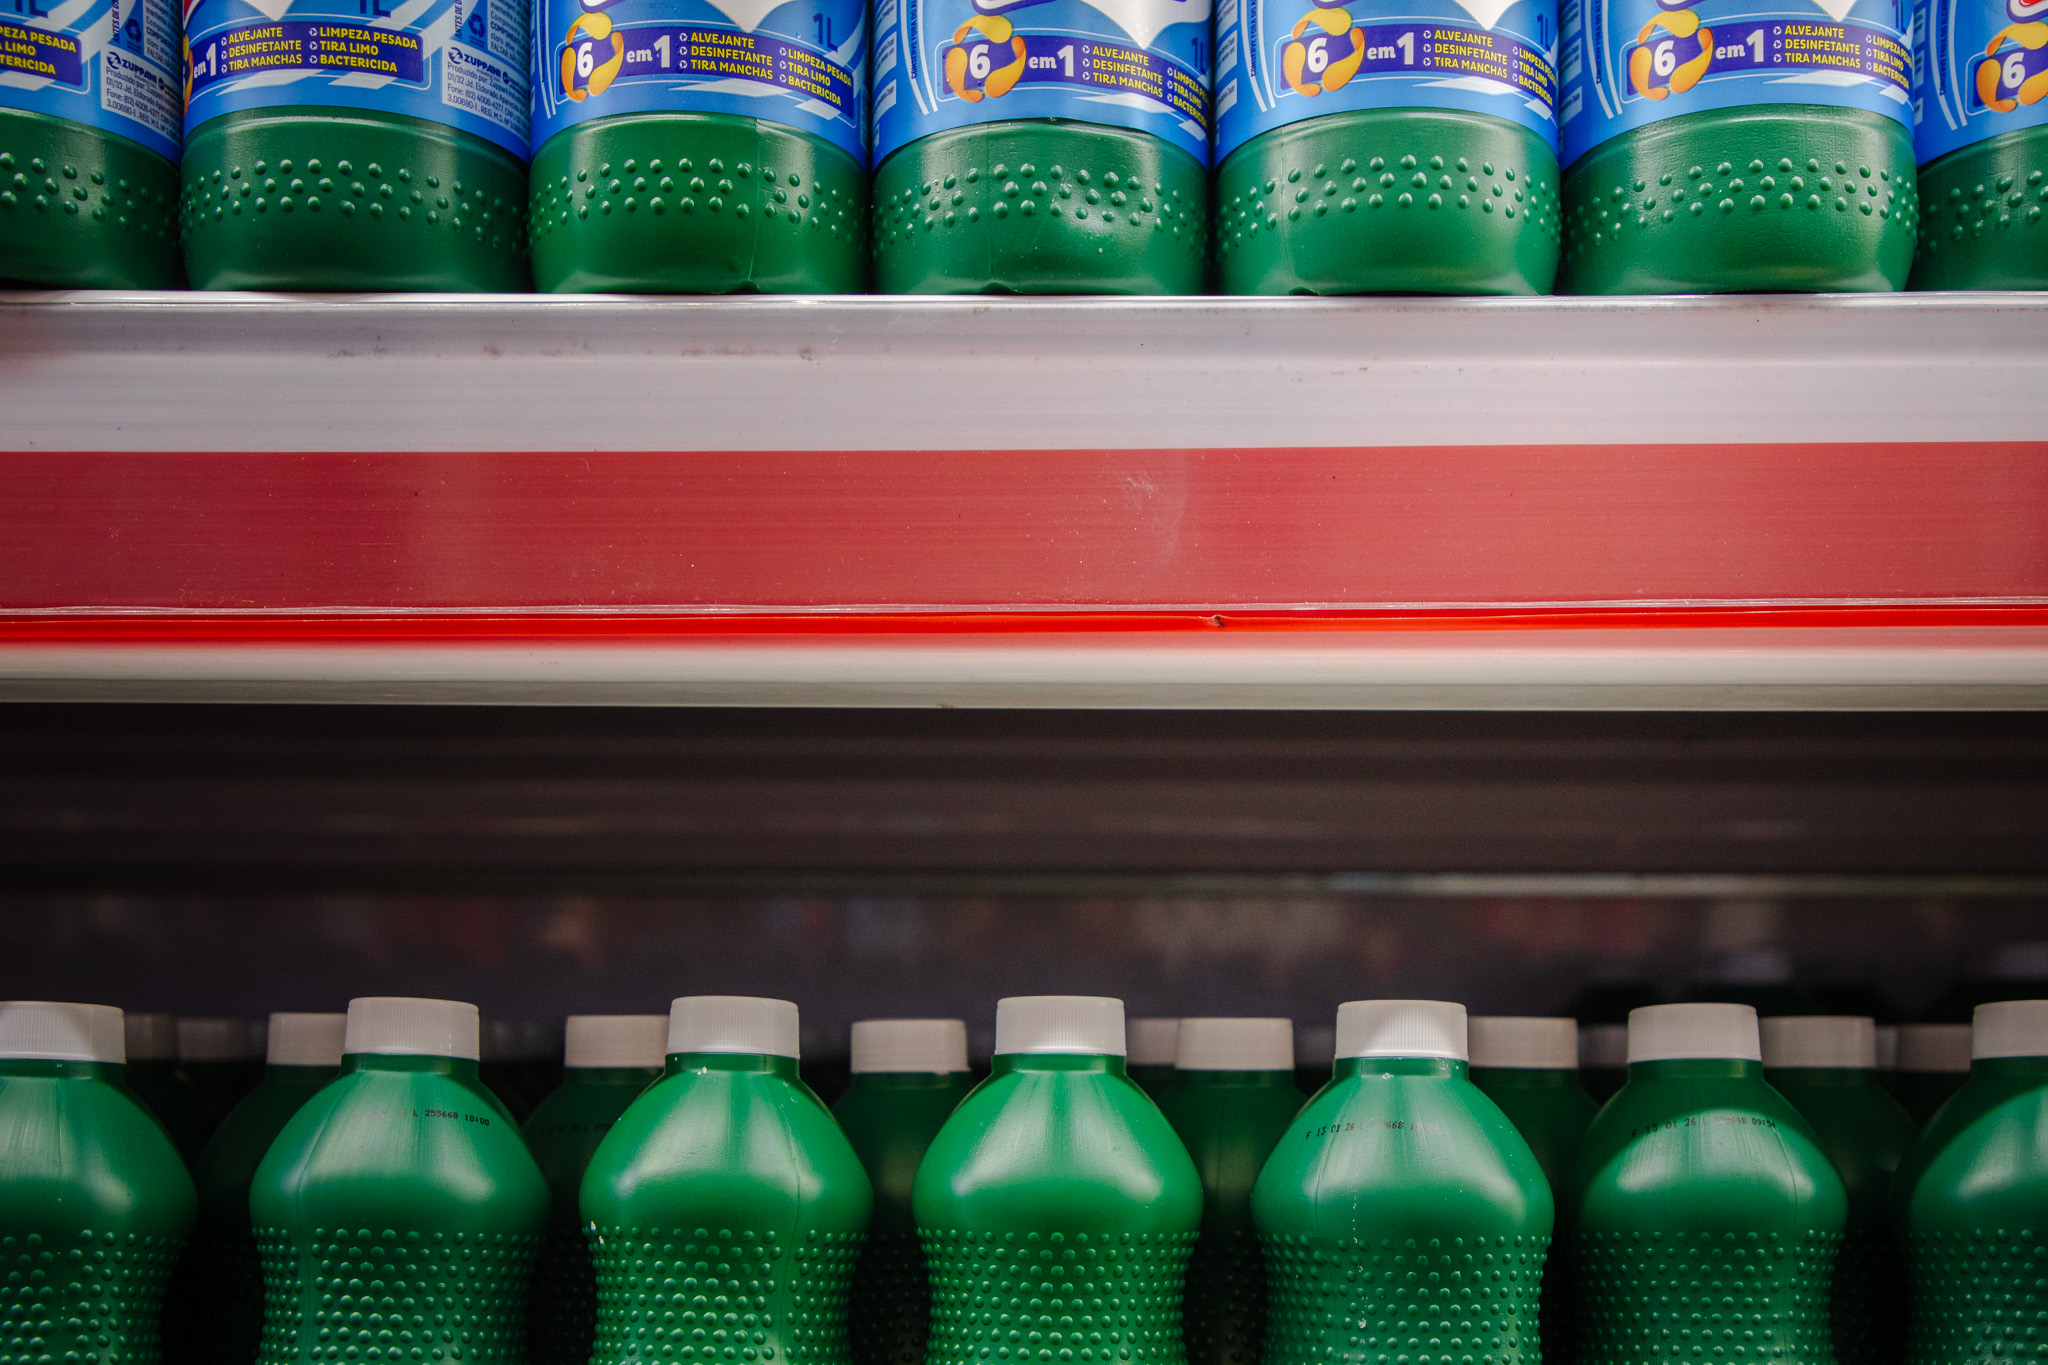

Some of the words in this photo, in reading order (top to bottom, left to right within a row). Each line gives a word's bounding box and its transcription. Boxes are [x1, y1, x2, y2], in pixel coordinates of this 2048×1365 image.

[112, 9, 119, 20] DE
[454, 5, 462, 16] DE
[112, 20, 120, 44] ANTES
[228, 27, 283, 44] ALVEJANTE
[320, 27, 371, 41] LIMPEZA
[373, 32, 418, 50] PESADA
[454, 16, 462, 39] ANTES
[813, 13, 838, 53] 1L
[1434, 29, 1493, 48] ALVEJANTE
[1537, 13, 1551, 54] 1L
[1785, 25, 1845, 39] ALVEJANTE
[5, 40, 36, 56] LIMO
[30, 31, 77, 53] PESADA
[229, 40, 302, 58] DESINFETANTE
[320, 41, 347, 52] TIRA
[349, 42, 379, 56] LIMO
[690, 32, 755, 49] ALVEJANTE
[1785, 39, 1860, 55] DESINFETANTE
[1873, 35, 1901, 56] LIMPEZA
[194, 61, 206, 79] em
[206, 42, 216, 76] 1
[229, 58, 249, 71] TIRA
[251, 54, 303, 68] MANCHAS
[320, 54, 398, 73] BACTERICIDA
[577, 42, 594, 78] 6
[626, 49, 652, 63] em
[653, 35, 670, 68] 1
[691, 46, 773, 67] DESINFETANTE
[969, 44, 991, 79] 6
[1029, 56, 1057, 69] em
[1057, 45, 1074, 77] 1
[1093, 46, 1149, 66] ALVEJANTE
[1192, 36, 1207, 76] 1L
[1307, 37, 1328, 73] 6
[1367, 46, 1396, 60] em
[1397, 32, 1414, 65] 1
[1434, 43, 1508, 65] DESINFETANTE
[1519, 47, 1545, 72] LIMPEZA
[1654, 40, 1676, 77] 6
[1715, 44, 1746, 60] em
[1746, 29, 1764, 63] 1
[1785, 52, 1810, 63] TIRA
[1812, 53, 1861, 69] MANCHAS
[1873, 48, 1890, 63] TIRA
[1890, 55, 1904, 71] LIMO
[106, 66, 134, 84] Produzido
[122, 58, 156, 83] ZUPPANI
[447, 61, 476, 79] Produzido
[463, 52, 500, 77] ZUPPANI
[691, 59, 717, 71] TIRA
[719, 62, 773, 80] MANCHAS
[788, 48, 826, 72] LIMPEZA
[827, 63, 852, 88] PESADA
[788, 62, 810, 78] TIRA
[811, 70, 831, 87] LIMO
[1093, 59, 1163, 85] DESINFETANTE
[1434, 57, 1459, 68] TIRA
[1461, 59, 1508, 79] MANCHAS
[1519, 60, 1535, 77] TIRA
[1535, 69, 1547, 88] LIMO
[1873, 62, 1909, 90] BACTERICIDA
[2002, 52, 2025, 89] 6
[106, 76, 122, 90] 01/32
[133, 88, 154, 105] Eldorado
[447, 72, 464, 85] 01/32
[465, 79, 474, 88] Jd.
[475, 82, 498, 100] Eldorado
[447, 82, 463, 95] Fone:
[465, 88, 475, 100] (62)
[788, 75, 841, 106] BACTERICIDA
[1093, 72, 1117, 85] TIRA
[1119, 76, 1163, 98] MANCHAS
[1174, 69, 1199, 93] LIMPEZA
[1519, 74, 1553, 107] BACTERICIDA
[1173, 82, 1189, 98] TIRA
[1189, 92, 1202, 109] LIMO
[413, 1109, 419, 1117] L
[424, 1109, 459, 1120] 255668
[464, 1113, 490, 1126] 10:00
[1646, 1123, 1658, 1133] 13
[1666, 1121, 1677, 1129] 01
[1684, 1118, 1697, 1127] 26
[1305, 1131, 1311, 1140] F
[1316, 1126, 1327, 1137] 13
[1330, 1124, 1340, 1133] 01
[1345, 1122, 1355, 1131] 26
